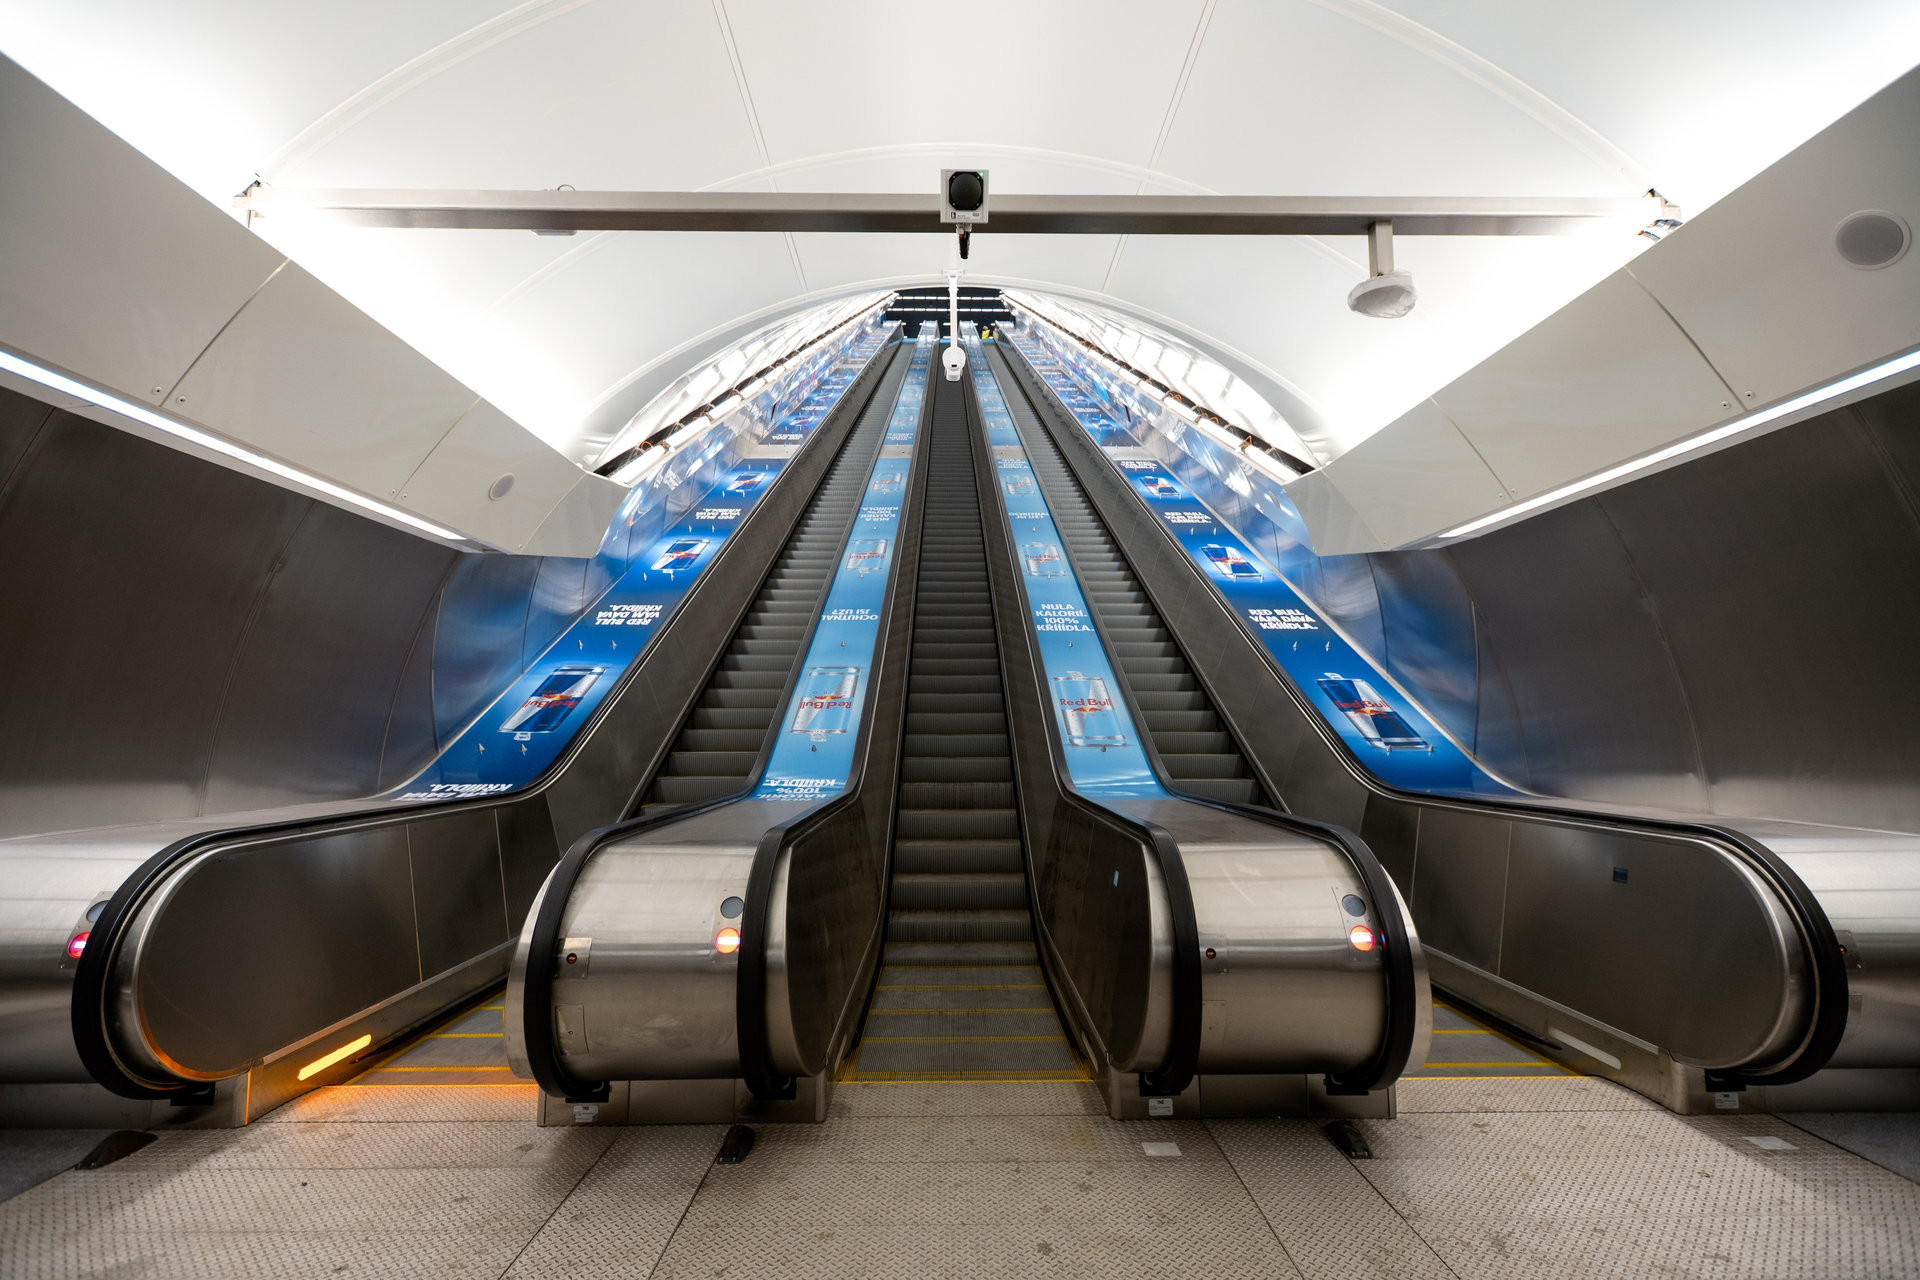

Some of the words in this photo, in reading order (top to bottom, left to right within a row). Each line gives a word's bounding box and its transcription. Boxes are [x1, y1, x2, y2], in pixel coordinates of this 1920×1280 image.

[1248, 608, 1273, 616] RED
[1273, 608, 1305, 616] BULL
[521, 700, 550, 709] Bull
[550, 700, 578, 709] Red
[800, 701, 824, 710] Bull
[824, 701, 852, 710] Red
[1060, 698, 1085, 706] Red
[1087, 698, 1112, 706] Bull
[1334, 700, 1362, 708] Red
[1362, 700, 1390, 708] Bull
